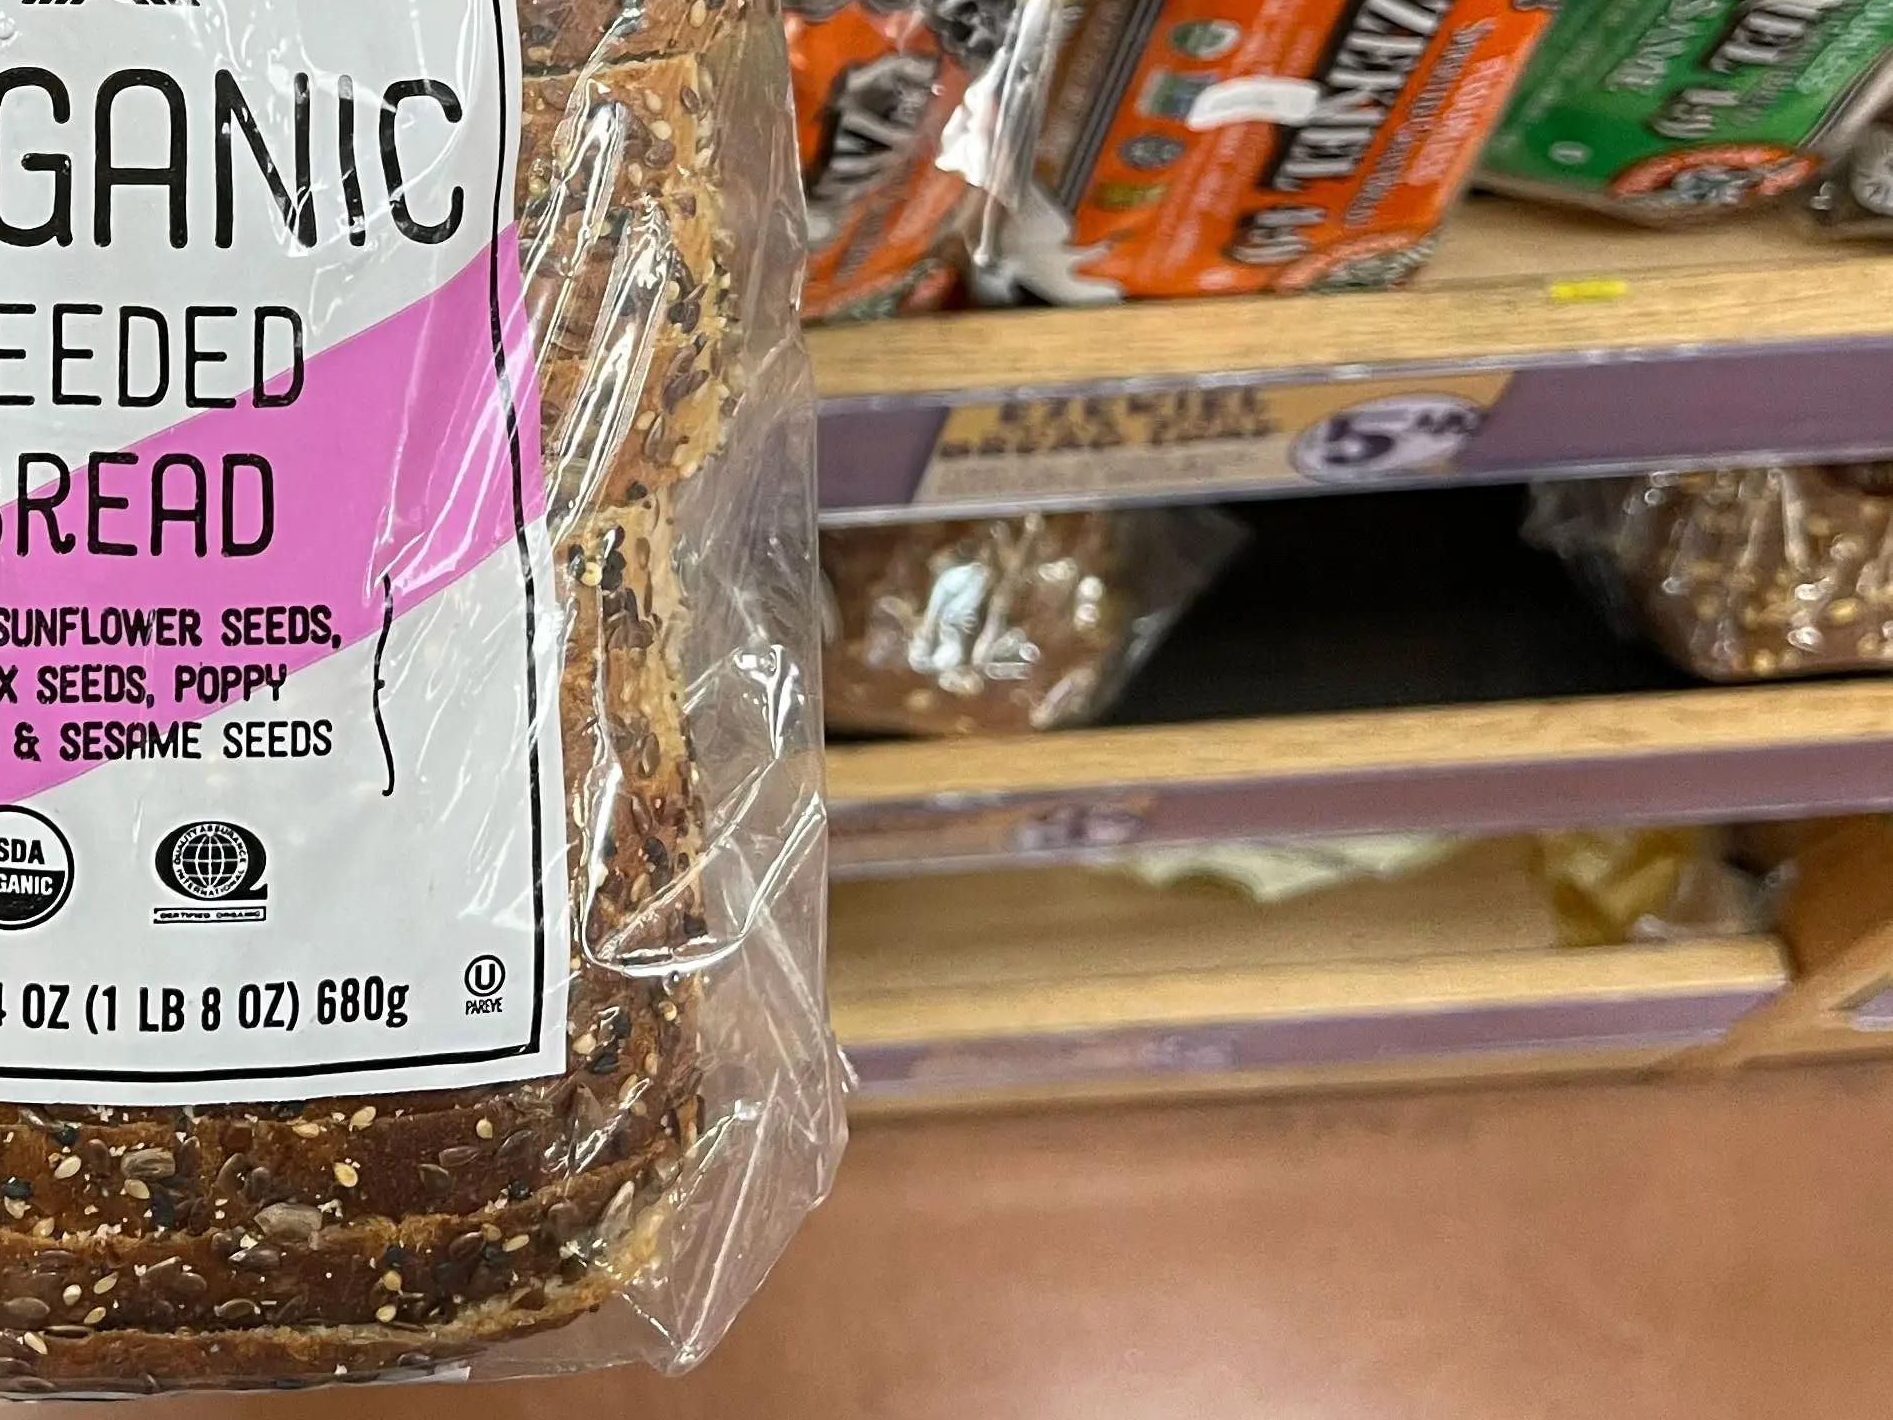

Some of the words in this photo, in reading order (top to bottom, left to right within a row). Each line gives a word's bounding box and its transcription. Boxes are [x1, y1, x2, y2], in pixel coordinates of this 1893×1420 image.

[221, 604, 342, 649] SEEDS,
[36, 663, 155, 709] SEEDS,
[174, 662, 287, 705] POPPY
[13, 721, 42, 762] &
[59, 720, 202, 762] SESAME
[223, 719, 333, 759] SEEDS
[22, 984, 70, 1029] OZ
[85, 984, 117, 1034] (1
[140, 987, 185, 1031] LB
[201, 986, 221, 1031] 8
[238, 982, 300, 1031] OZ)
[317, 976, 410, 1027] 680g
